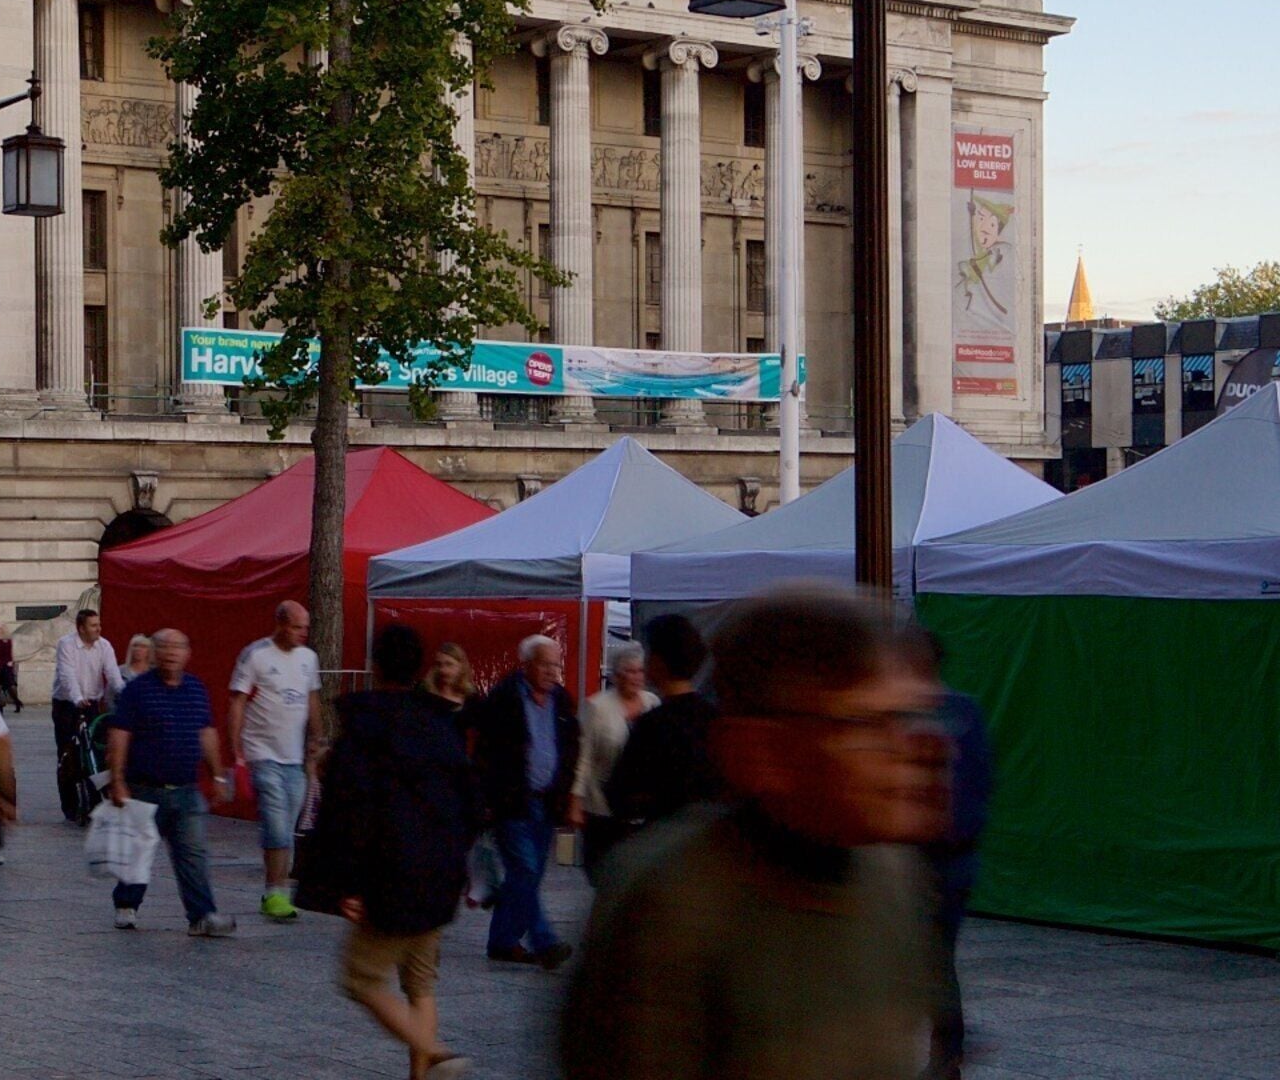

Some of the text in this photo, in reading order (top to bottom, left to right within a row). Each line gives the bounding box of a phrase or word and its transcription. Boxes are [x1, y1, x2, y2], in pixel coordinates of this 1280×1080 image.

[956, 141, 1012, 159] WANTED
[956, 160, 1012, 171] LOW ENERGY
[973, 170, 998, 180] BILLS
[190, 334, 216, 346] Your
[218, 337, 249, 348] brand
[462, 364, 519, 387] Village
